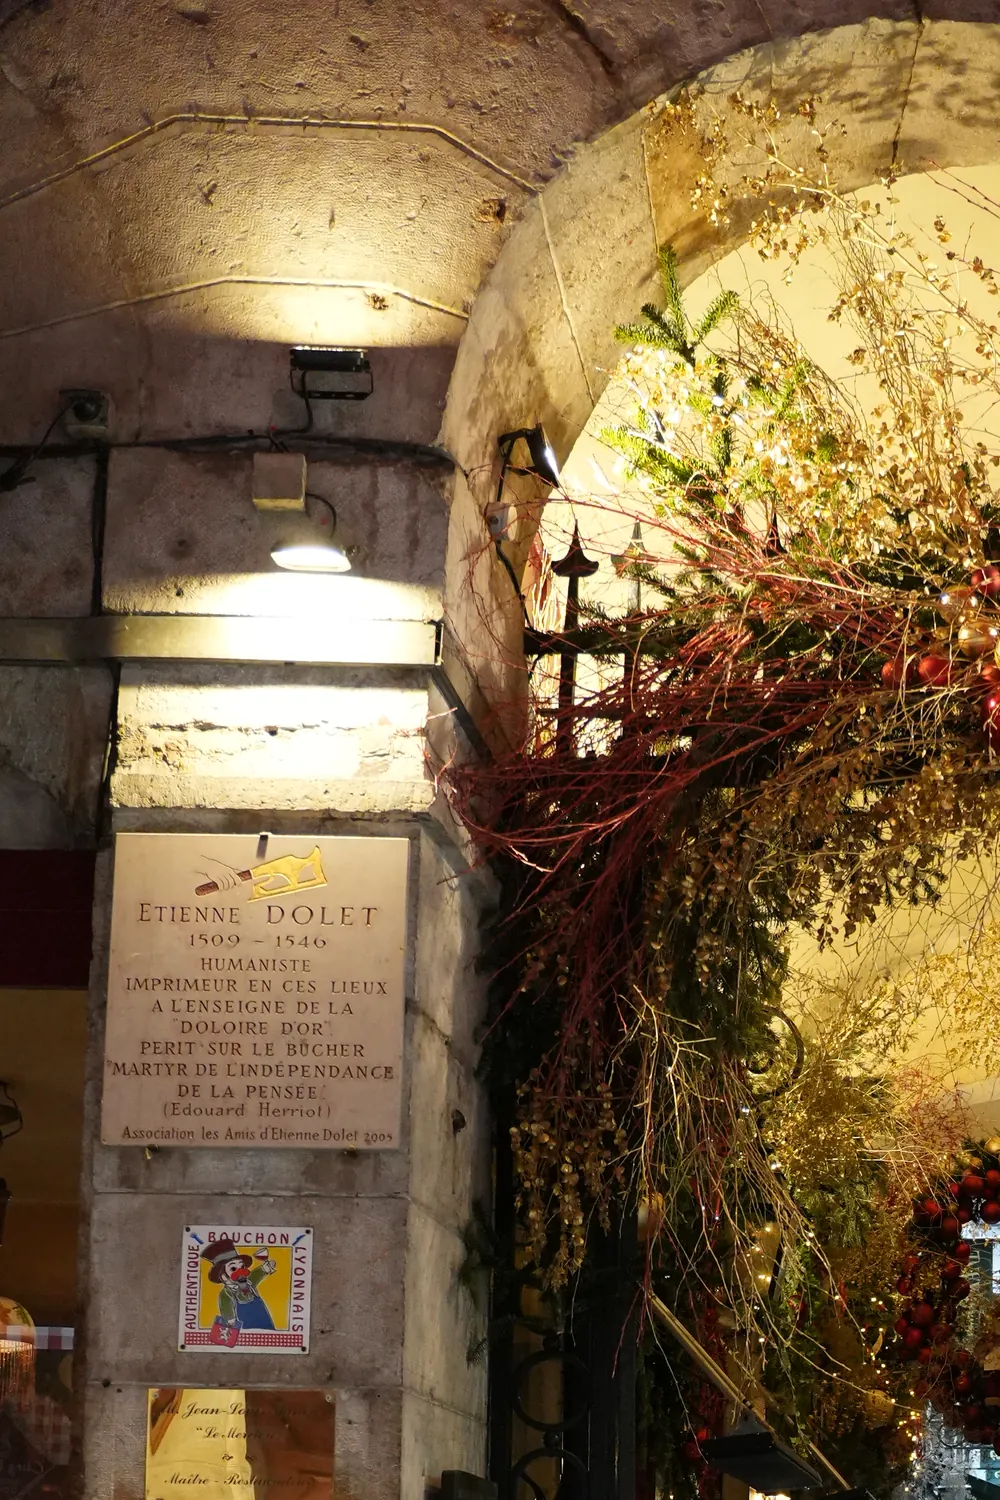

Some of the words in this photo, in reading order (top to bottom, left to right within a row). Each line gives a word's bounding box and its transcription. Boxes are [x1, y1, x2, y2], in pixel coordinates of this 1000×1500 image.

[138, 903, 240, 924] ETIENNE
[266, 905, 378, 926] DOLET
[190, 934, 240, 948] 1509
[276, 935, 328, 949] 1546
[201, 957, 311, 973] HUMANISTE
[126, 978, 237, 992] IMPRIMEUR
[249, 979, 272, 993] EN
[283, 980, 316, 994] CES
[331, 981, 388, 995] LIEUX
[152, 999, 163, 1013] A
[172, 998, 284, 1014] L'ENSEIGNE
[296, 1001, 320, 1015] DE
[329, 1001, 354, 1015] LA
[141, 1041, 196, 1055] PERIT
[208, 1042, 243, 1056] SUR
[252, 1043, 274, 1057] LE
[196, 1063, 217, 1077] DE
[178, 1084, 200, 1098] DE
[211, 1085, 235, 1099] LA
[164, 1102, 244, 1117] (Edouard
[259, 1102, 331, 1119] Herriot)
[122, 1126, 195, 1141] Association
[201, 1126, 219, 1141] les
[225, 1127, 255, 1141] Amis
[323, 1127, 358, 1142] Dolet
[208, 1231, 290, 1245] BOUCHON
[185, 1244, 200, 1330] AUTHENTIQUE
[292, 1246, 306, 1332] LYONNAIS
[164, 1473, 209, 1485] Maître
